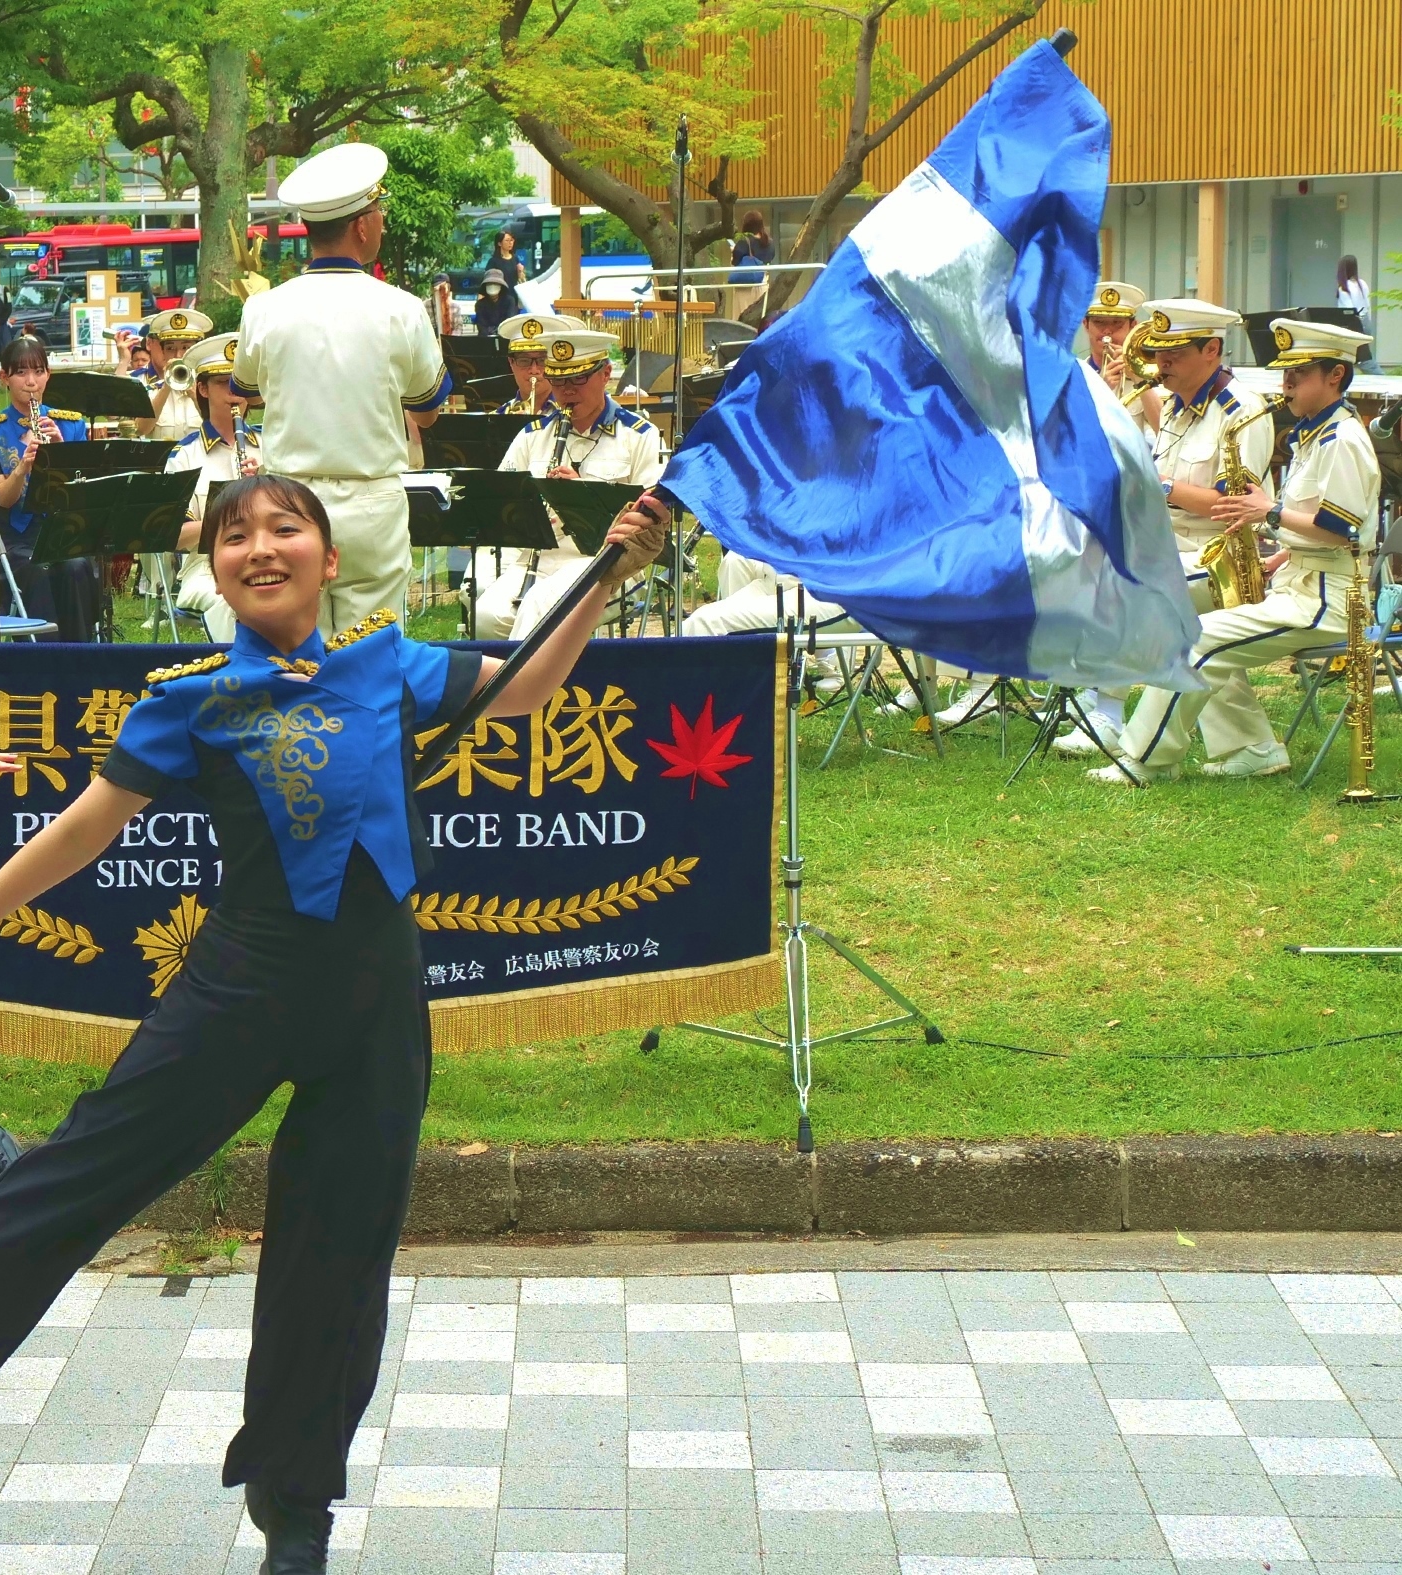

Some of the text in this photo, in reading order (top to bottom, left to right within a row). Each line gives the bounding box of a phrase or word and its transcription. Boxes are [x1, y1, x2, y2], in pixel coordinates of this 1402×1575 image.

[426, 813, 502, 848] ICE
[516, 810, 646, 848] BAND
[96, 859, 202, 888] SINCE
[424, 938, 660, 986] 警友会 広島県警察友の会
